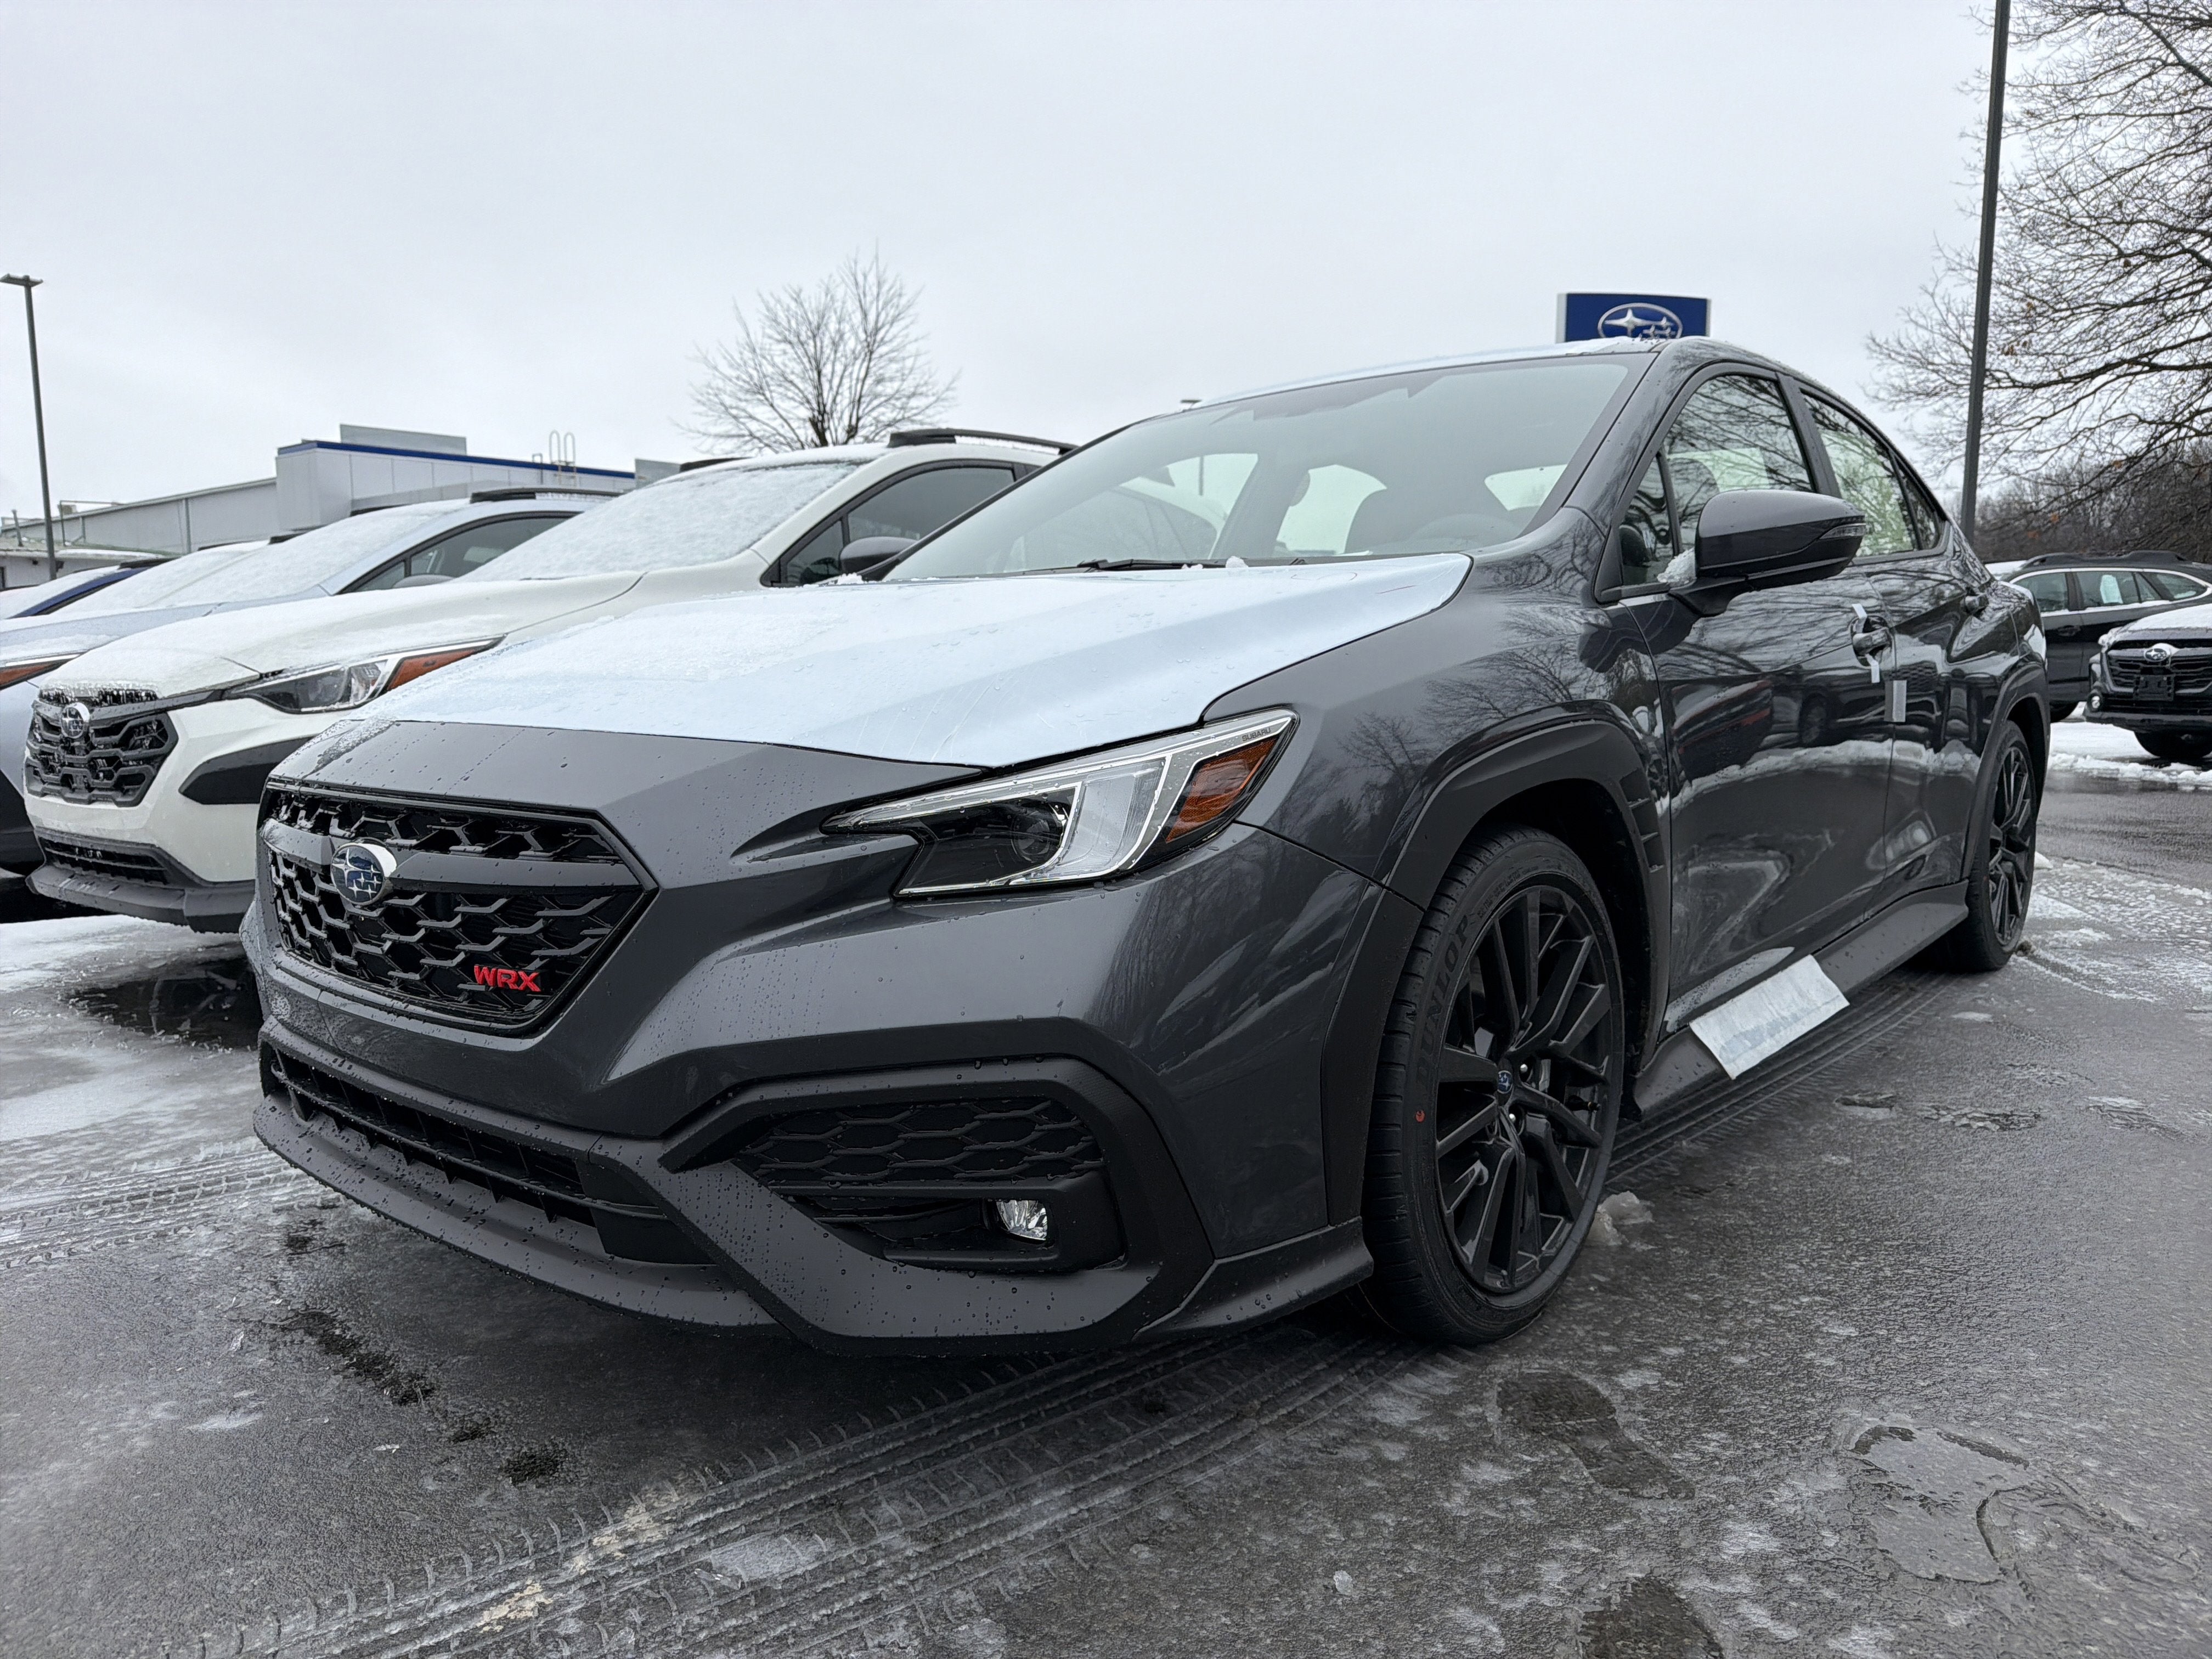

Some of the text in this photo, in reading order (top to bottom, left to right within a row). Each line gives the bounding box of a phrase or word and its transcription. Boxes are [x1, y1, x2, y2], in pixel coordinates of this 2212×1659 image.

[1242, 727, 1271, 742] SUBARU
[473, 964, 541, 992] WRX
[1416, 914, 1468, 1089] DUNLOP
